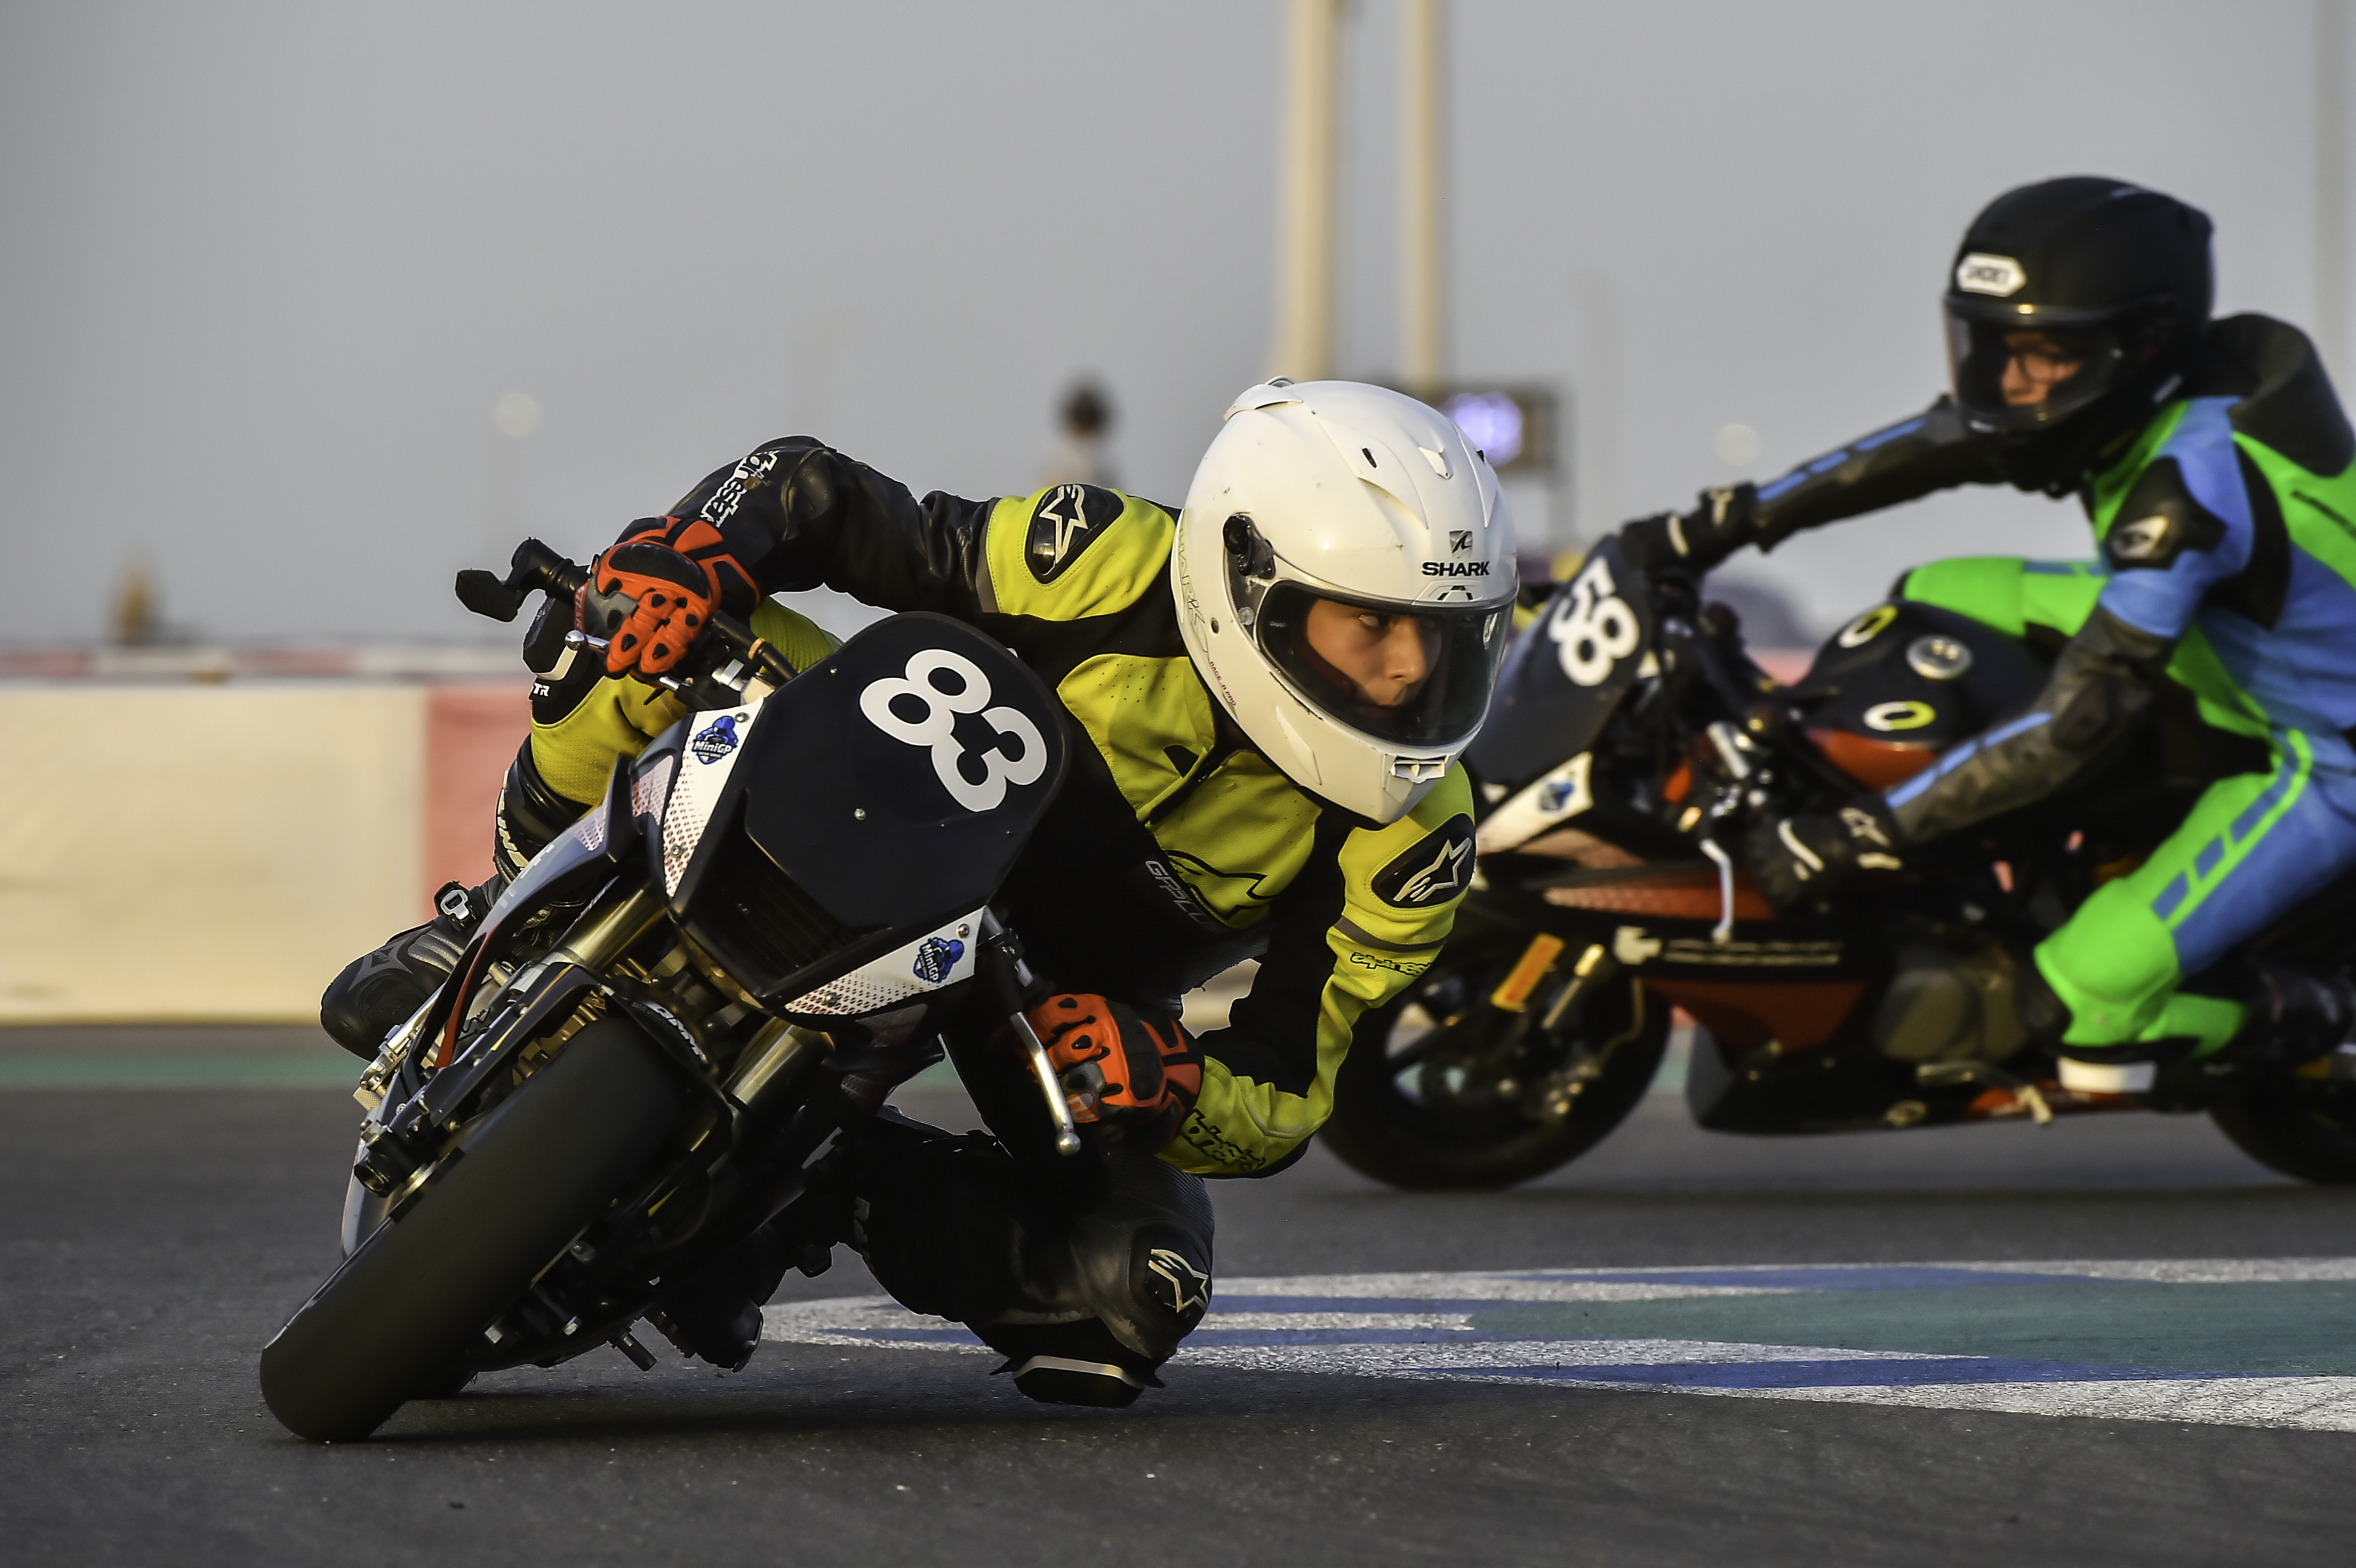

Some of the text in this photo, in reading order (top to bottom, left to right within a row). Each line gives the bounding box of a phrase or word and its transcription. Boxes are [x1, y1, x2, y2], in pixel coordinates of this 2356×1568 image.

[1421, 560, 1490, 577] SHARK
[1548, 555, 1640, 686] 58
[693, 740, 732, 754] MiniGP
[860, 649, 1047, 812] 83
[921, 943, 939, 981] MiniGP
